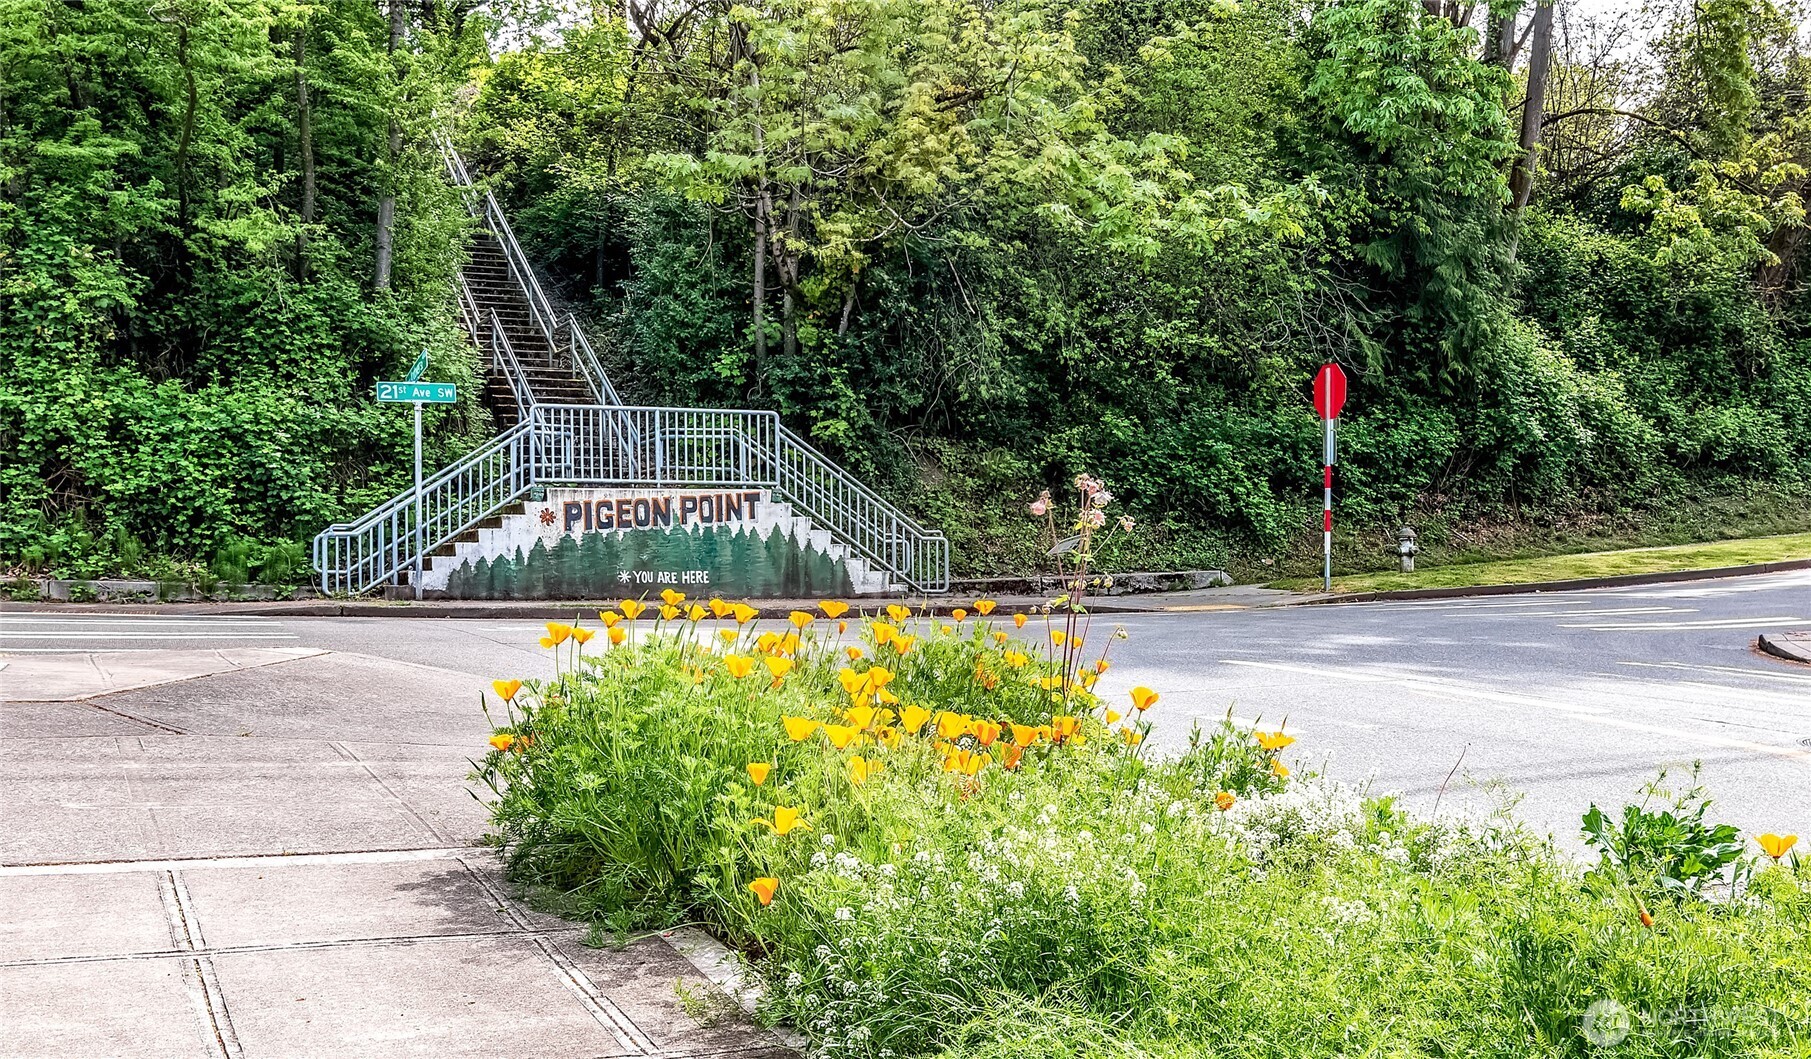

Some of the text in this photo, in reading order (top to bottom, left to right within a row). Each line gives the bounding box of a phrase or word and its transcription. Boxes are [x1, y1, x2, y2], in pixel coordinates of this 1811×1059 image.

[380, 384, 453, 399] 21st Ave SW
[563, 491, 761, 532] PIGEON POINT
[632, 570, 710, 584] YOU ARE HERE
